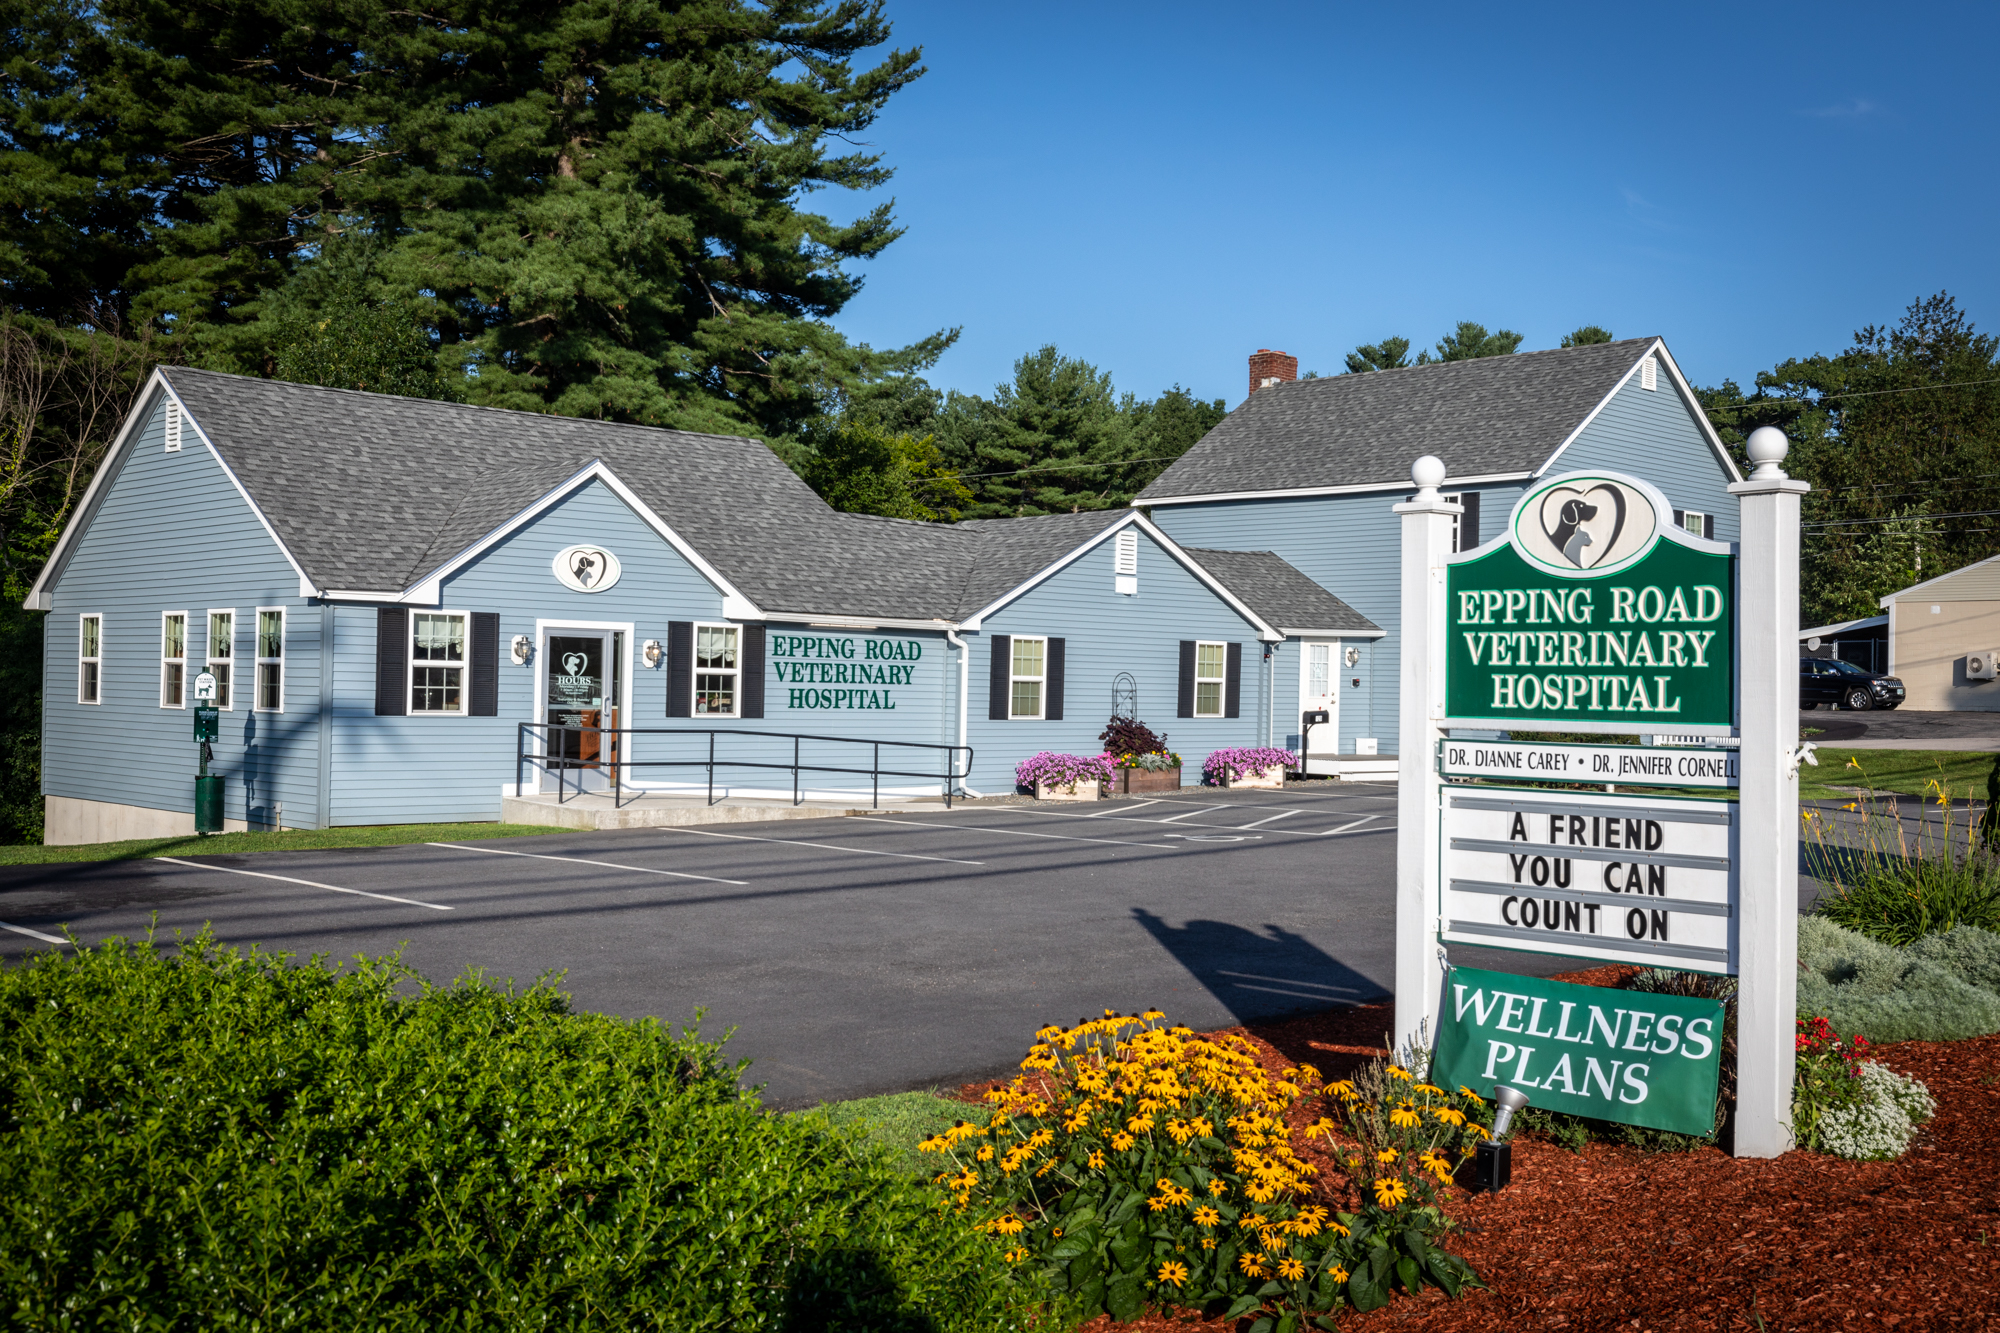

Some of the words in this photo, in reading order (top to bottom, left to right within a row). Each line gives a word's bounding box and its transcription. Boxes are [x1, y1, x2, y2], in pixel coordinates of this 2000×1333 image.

[1457, 588, 1594, 624] EPPING
[1609, 585, 1723, 623] ROAD
[772, 635, 855, 658] EPPING
[865, 639, 922, 660] ROAD
[1462, 631, 1716, 668] VETERINARY
[774, 661, 915, 685] VETERINARY
[1490, 673, 1681, 712] HOSPITAL
[788, 688, 896, 709] HOSPITAL
[1449, 748, 1470, 766] DR.
[1475, 749, 1522, 769] DIANNE
[1527, 751, 1570, 771] CAREY
[1593, 754, 1614, 773] DR.
[1618, 755, 1672, 777] JENNIFER
[1678, 757, 1737, 779] CORNELL
[1510, 811, 1528, 842] A
[1550, 814, 1663, 851] FRIEND
[1509, 853, 1571, 889] YOU
[1603, 861, 1665, 897] CAN
[1502, 895, 1600, 934] COUNT
[1626, 907, 1668, 941] ON
[1453, 983, 1713, 1061] WELLNESS
[1481, 1039, 1650, 1105] PLANS
